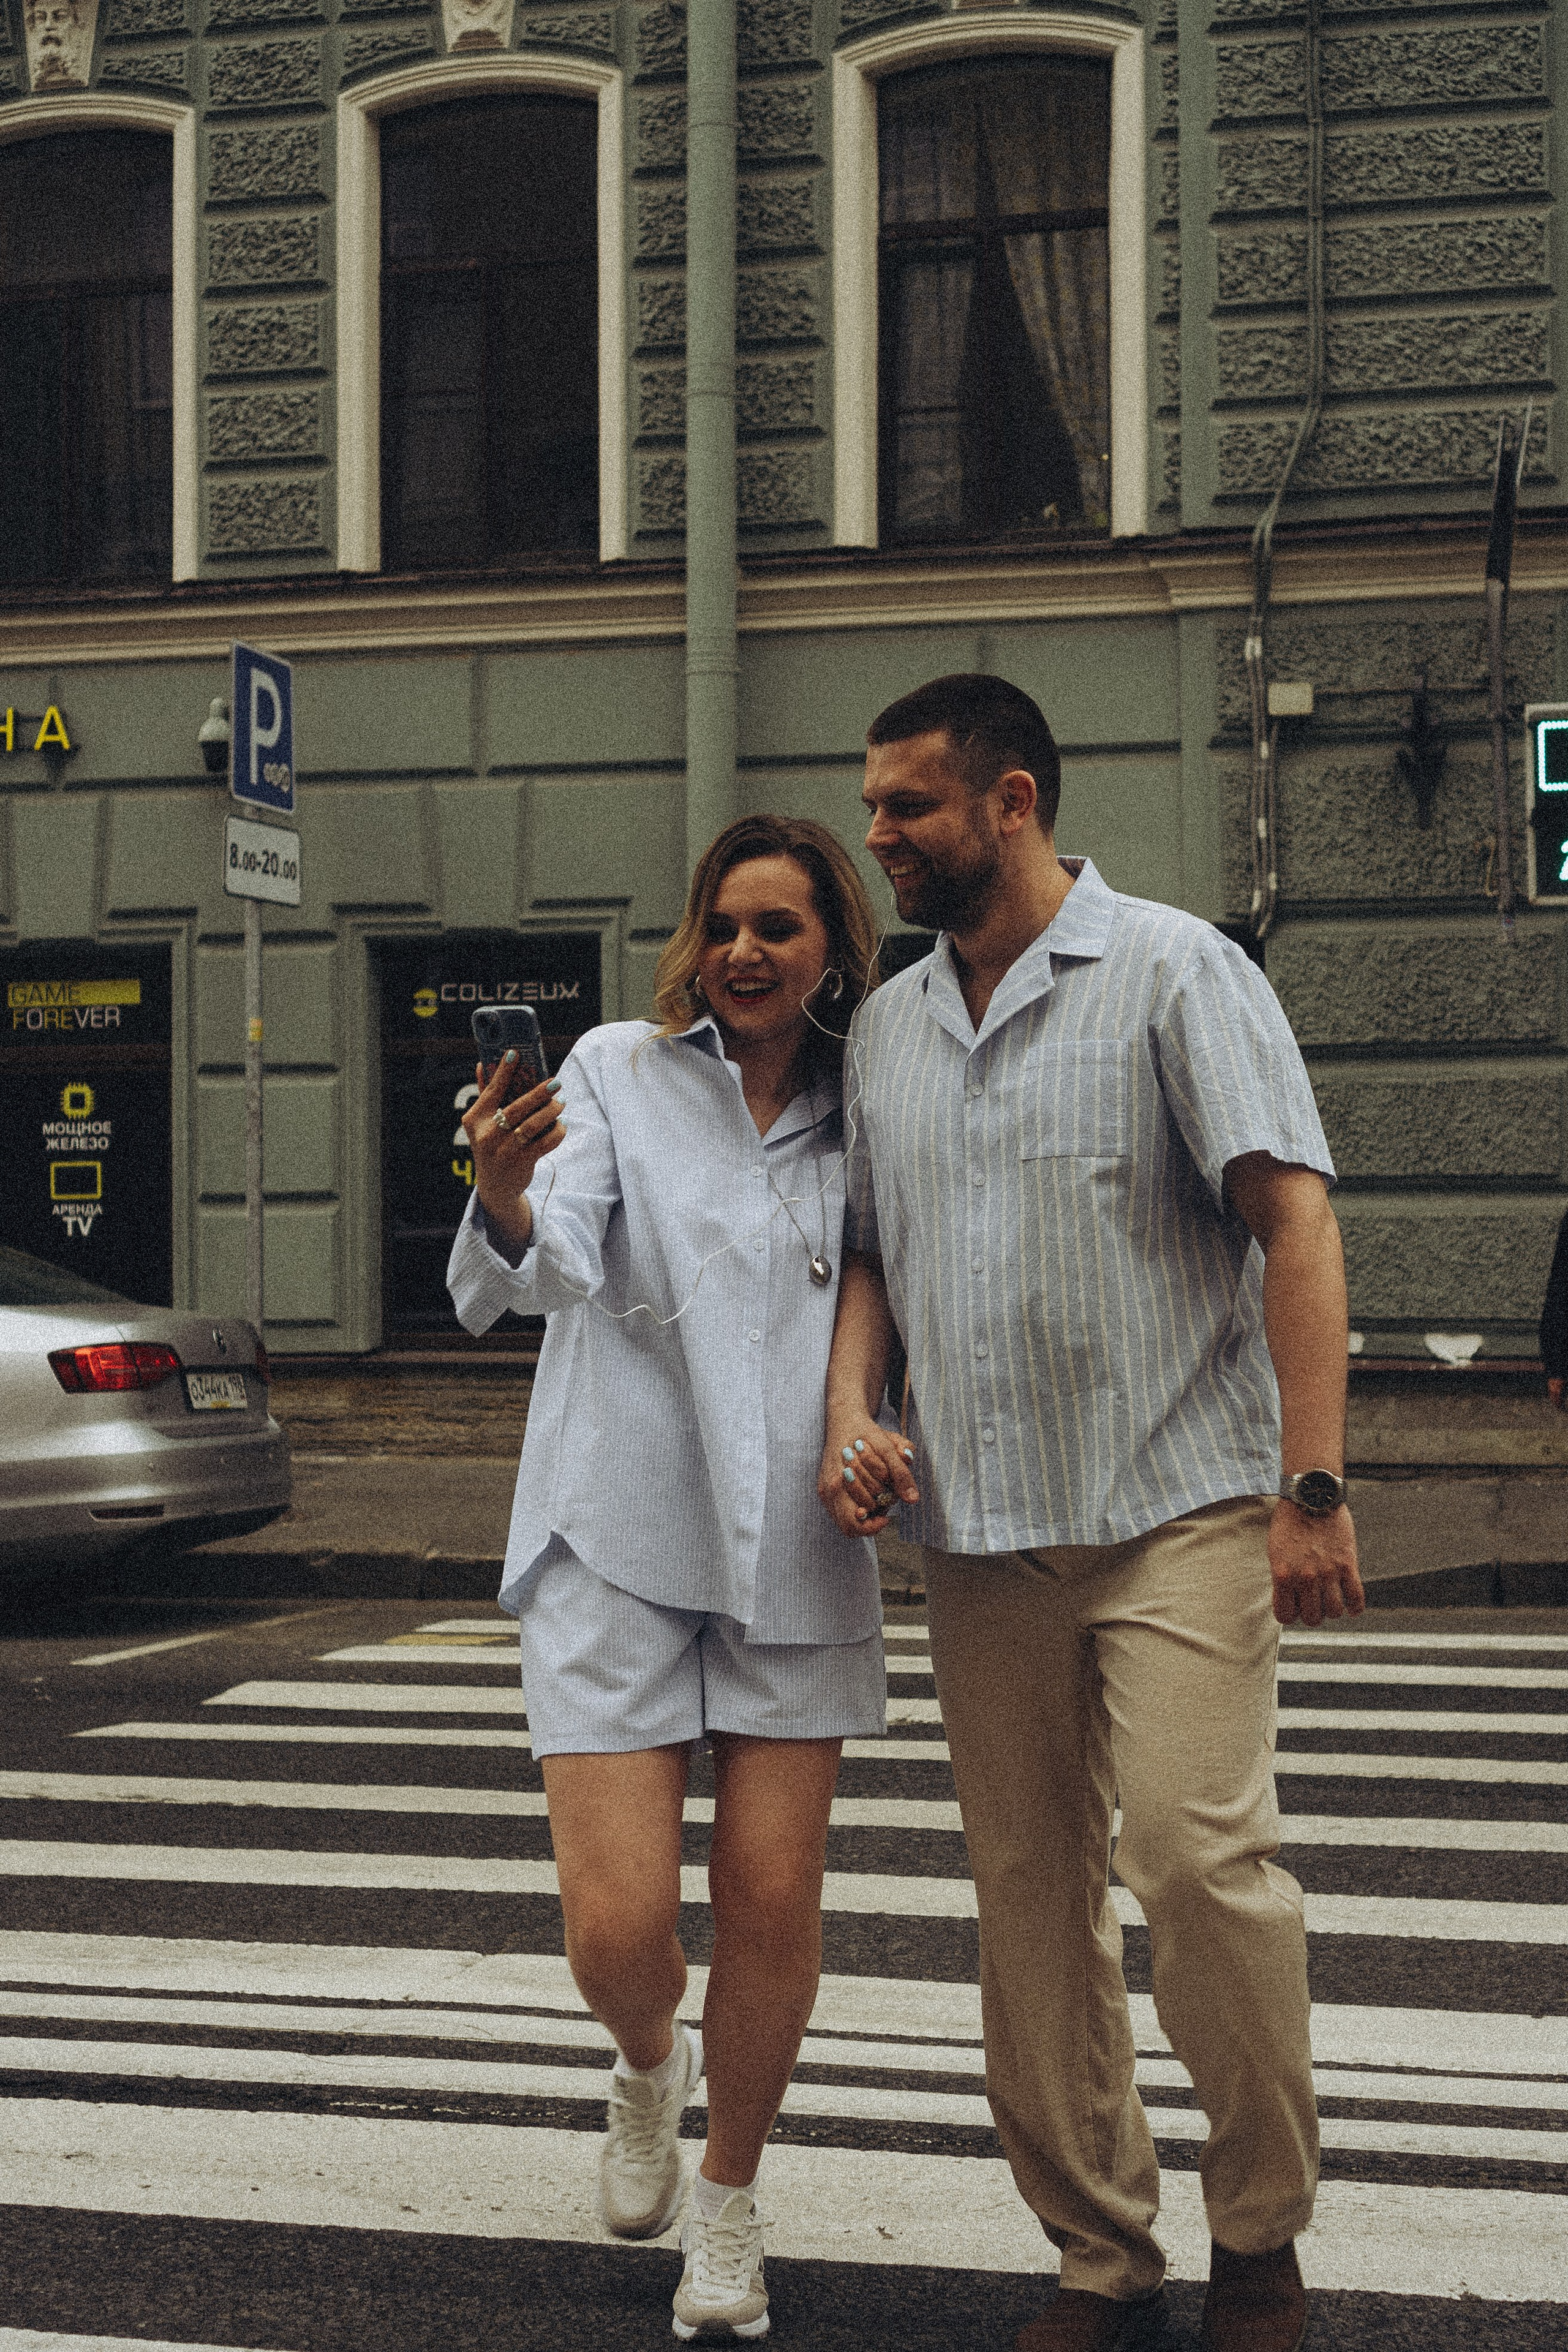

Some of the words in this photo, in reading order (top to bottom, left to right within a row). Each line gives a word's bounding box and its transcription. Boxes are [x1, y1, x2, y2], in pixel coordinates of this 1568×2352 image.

[230, 842, 297, 881] 8.00-20.00
[11, 982, 80, 1005] GAME
[440, 982, 579, 1002] COLIZEUM
[12, 1006, 121, 1031] FOREVER
[42, 1121, 112, 1136] МОЩНОЕ
[46, 1136, 110, 1151] ЖЕЛЕЗО
[52, 1203, 103, 1216] АРЕНДА
[62, 1216, 93, 1237] TV
